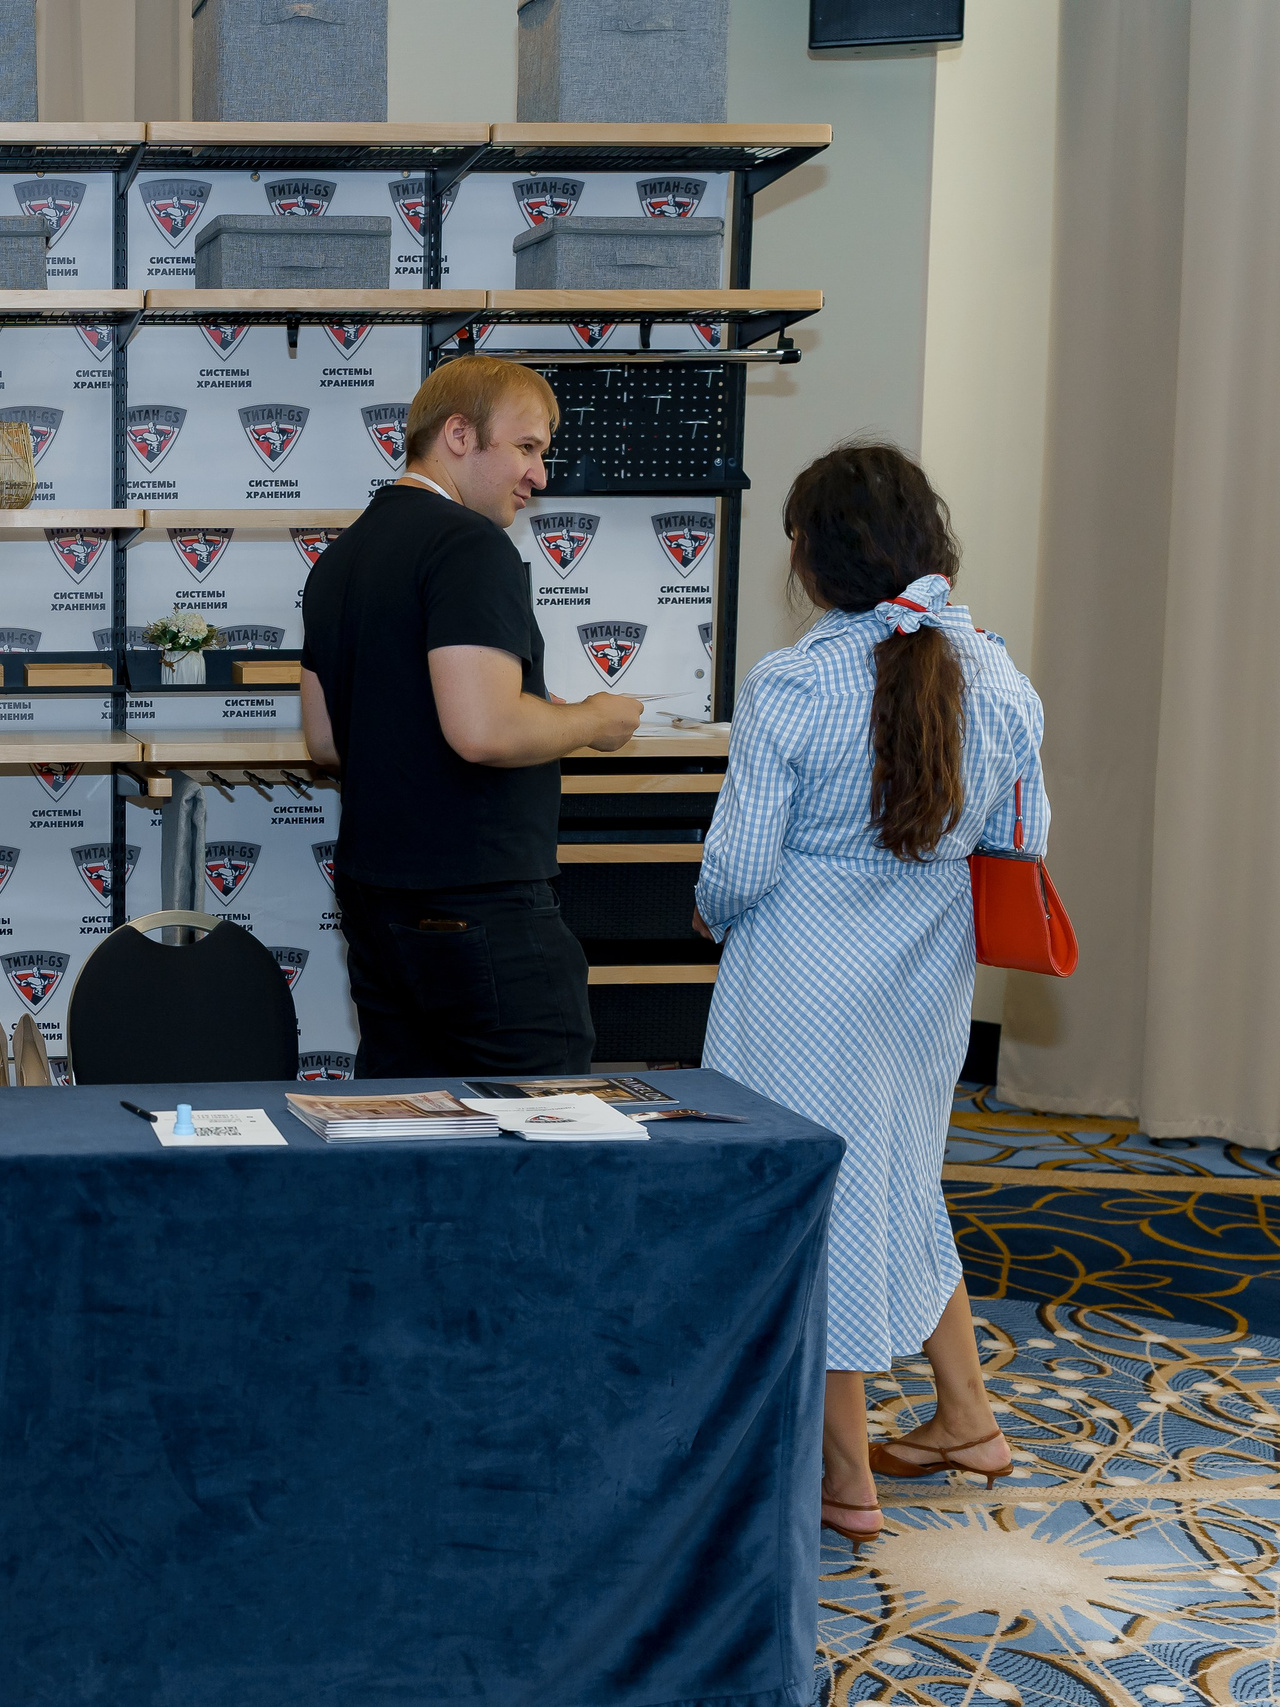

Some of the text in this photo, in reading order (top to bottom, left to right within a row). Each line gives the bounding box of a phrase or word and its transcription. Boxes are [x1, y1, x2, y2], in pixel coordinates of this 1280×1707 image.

[20, 184, 80, 199] ТИТАН-GS
[270, 183, 329, 197] ТИТАН-GS
[518, 181, 577, 196] ТИТАН-GS
[641, 181, 699, 196] ТИТАН-GS
[46, 257, 76, 265] ТЕМЫ
[46, 268, 78, 277] НЕНИЯ
[147, 268, 196, 276] ХРАНЕНИ
[199, 369, 250, 377] СИСТЕМЫ
[322, 368, 372, 376] СИСТЕМЫ
[196, 380, 252, 388] СИСТЕМЫ
[319, 379, 374, 387] СИСТЕМЫ
[128, 409, 181, 423] ИТАН-GS
[244, 408, 303, 422] ТИТАН-GS
[366, 407, 409, 421] ТИТАН-
[127, 480, 176, 489] СИСТЕМЫ
[249, 479, 298, 487] СИСТЕМЫ
[246, 490, 300, 499] СИСТЕМЫ
[535, 516, 594, 530] ТИТАН-GS
[539, 586, 589, 595] СИСТЕМЫ
[660, 585, 710, 593] СИСТЕМЫ
[176, 590, 225, 598] СИСТЕМЫ
[536, 597, 591, 606] СИСТЕМЫ
[657, 596, 712, 605] СИСТЕМЫ
[50, 603, 106, 611] СИСТЕМЫ
[173, 601, 228, 610] СИСТЕМЫ
[582, 625, 641, 639] ТИТАН-GS
[225, 699, 274, 707] СИСТЕМЫ
[222, 710, 277, 718] СИСТЕМЫ
[32, 809, 81, 817] СИСТЕМЫ
[273, 806, 322, 814] СИСТЕМЫ
[29, 820, 84, 828] СИСТЕМЫ
[271, 816, 325, 825] СИСТЕМЫ
[205, 845, 255, 859] ИТАН-GS
[5, 954, 63, 968] ТИТАН-GS
[299, 1054, 351, 1068] ИТАН-GS
